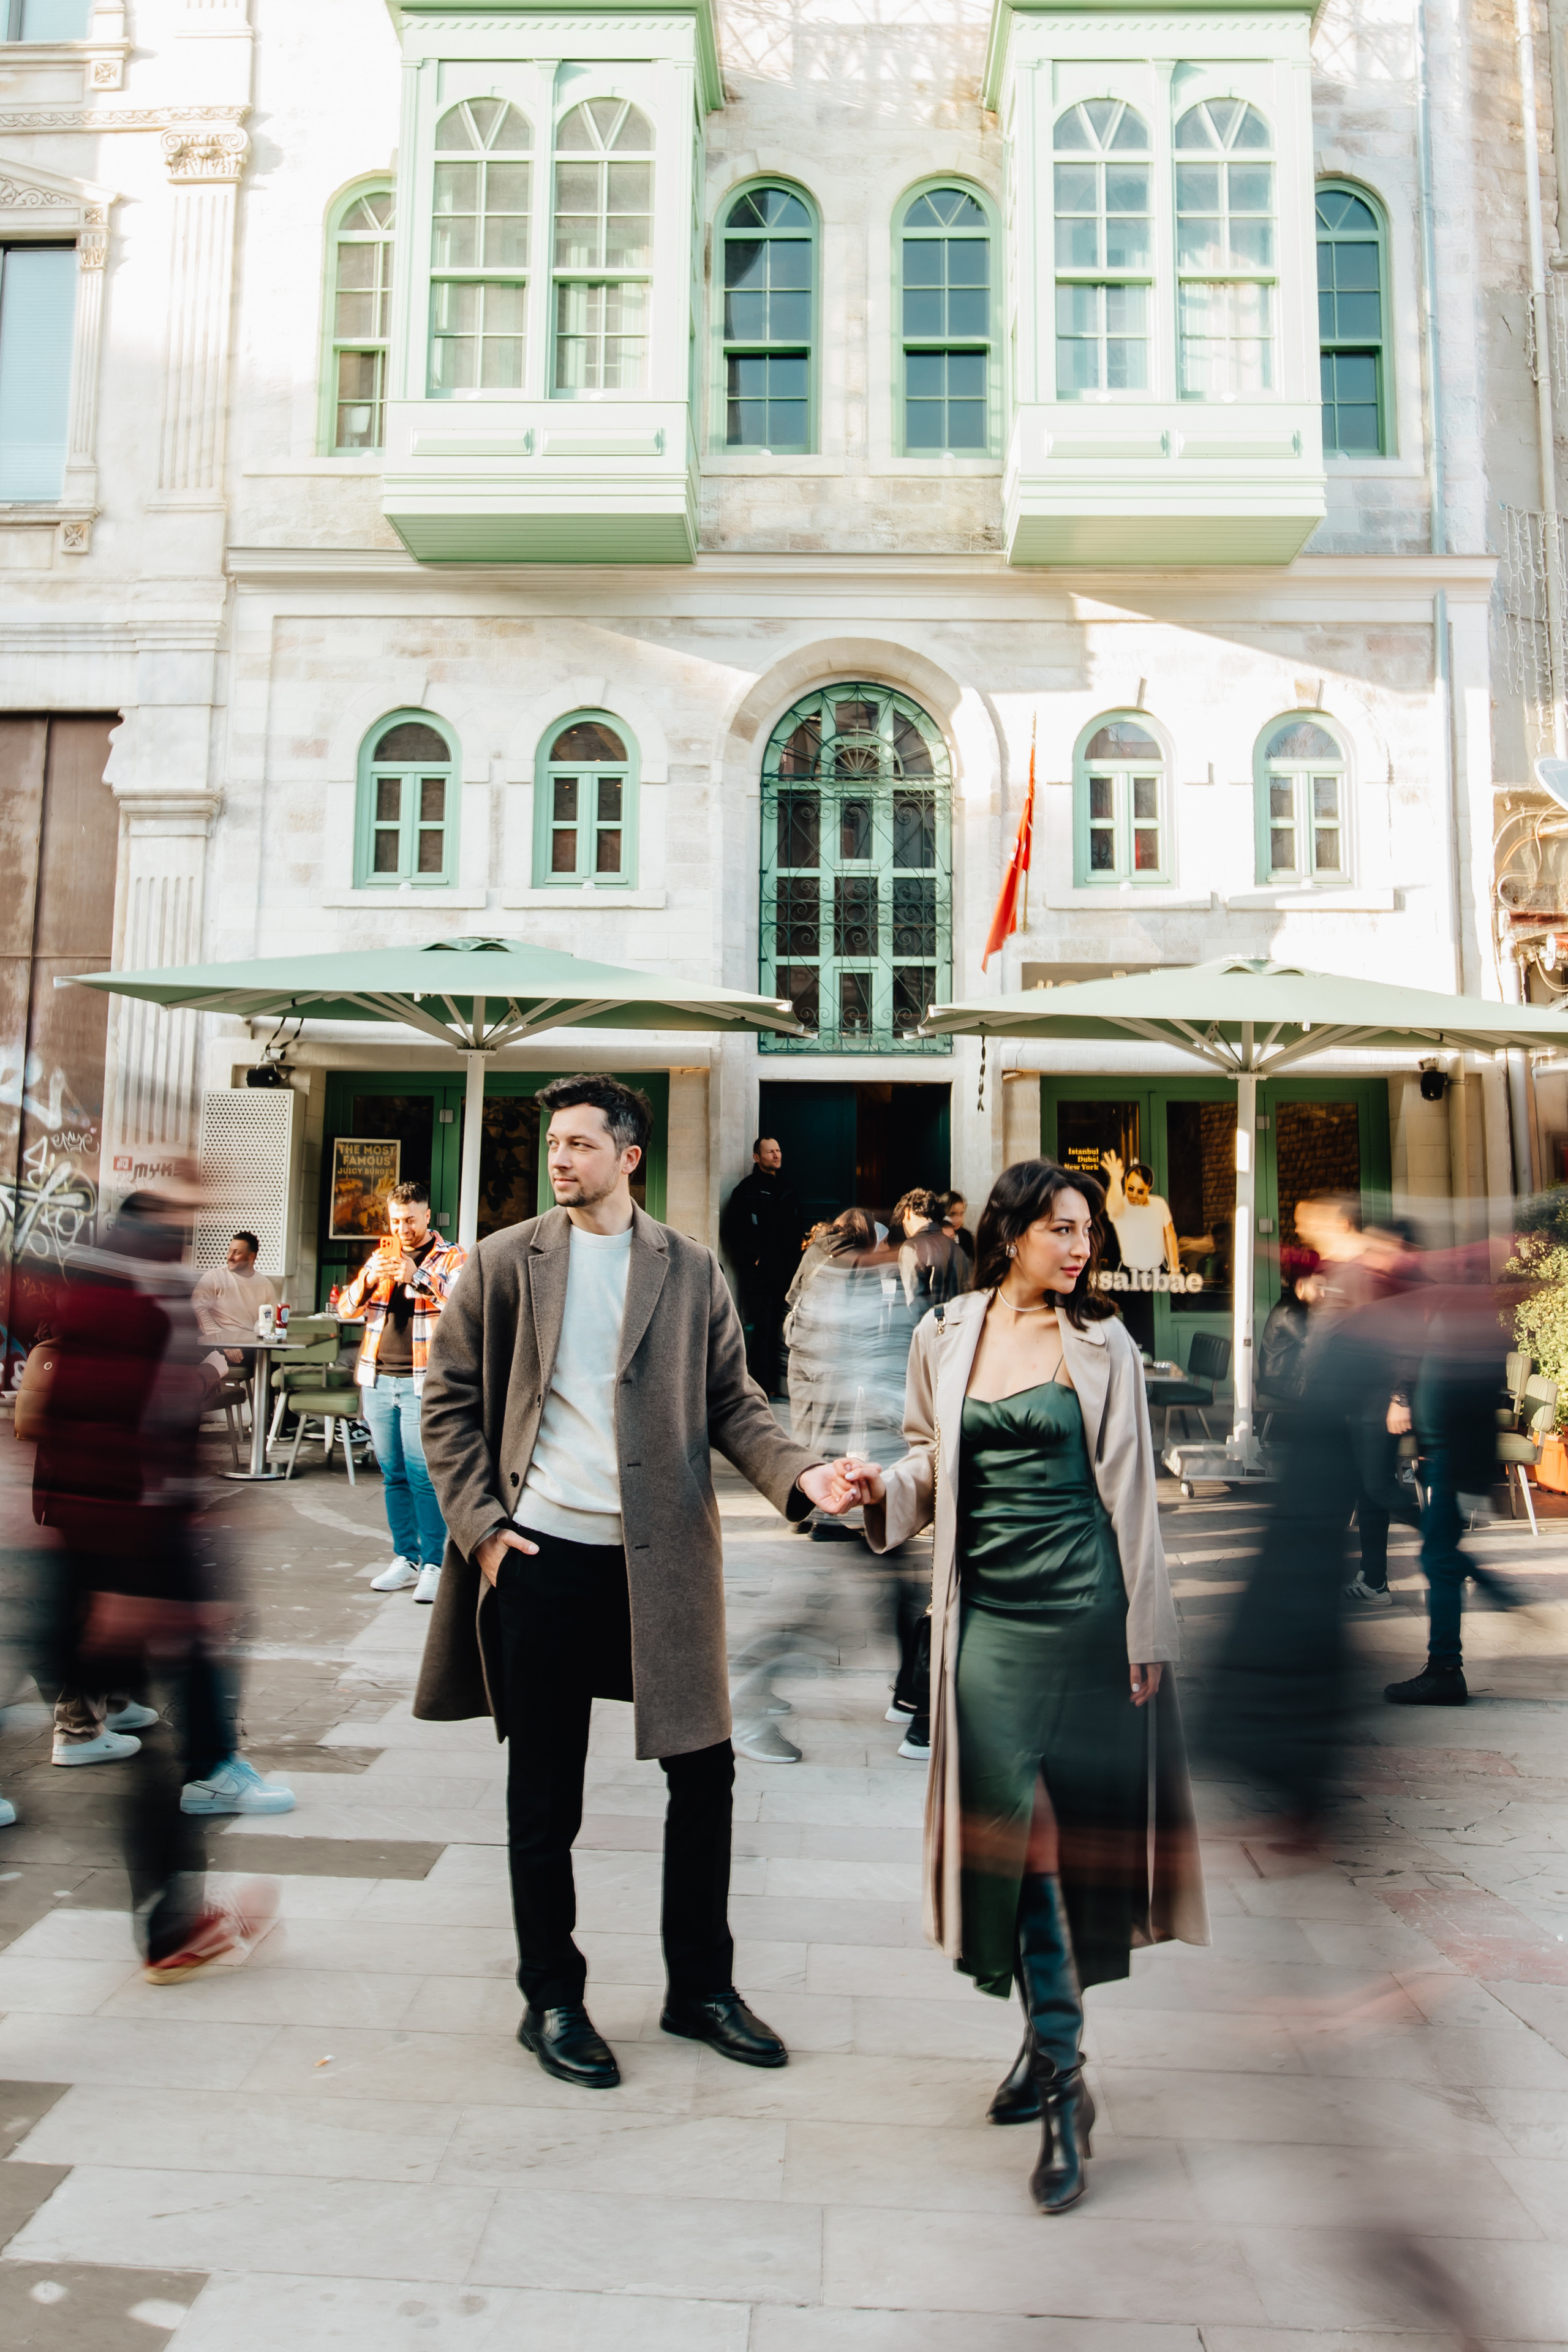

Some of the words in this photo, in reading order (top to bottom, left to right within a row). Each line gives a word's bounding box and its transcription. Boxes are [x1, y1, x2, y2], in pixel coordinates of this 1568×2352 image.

[337, 1144, 360, 1155] THE
[364, 1145, 396, 1156] MOST
[342, 1155, 391, 1166] FAMOUS
[1063, 1162, 1080, 1170] New
[1081, 1162, 1099, 1170] York
